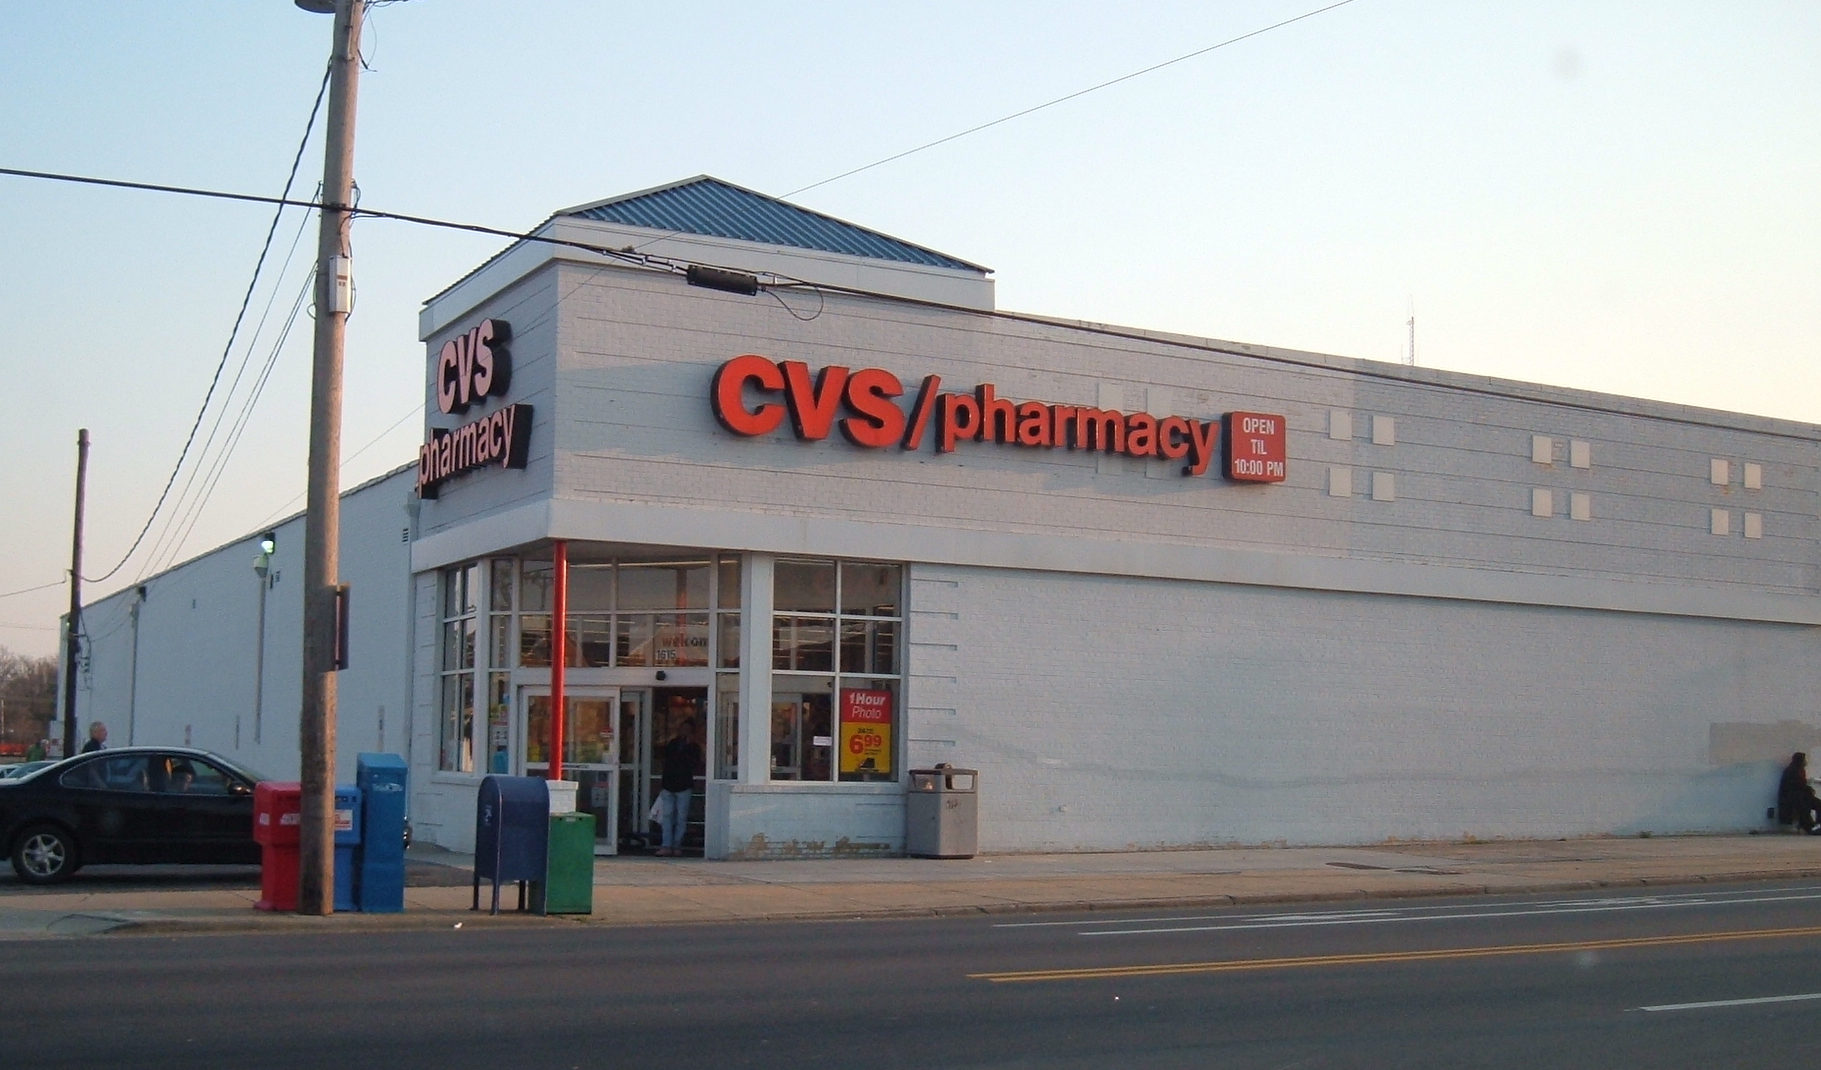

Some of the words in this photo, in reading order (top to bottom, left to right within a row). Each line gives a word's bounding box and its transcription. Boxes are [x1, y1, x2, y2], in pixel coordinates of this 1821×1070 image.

[437, 317, 501, 414] CVS
[1243, 417, 1275, 435] OPEN
[415, 403, 522, 499] pharmacy
[1250, 439, 1267, 455] TIL
[1234, 458, 1263, 475] 10:00
[1266, 461, 1284, 477] PM
[656, 649, 677, 659] 1615
[851, 706, 882, 719] Photo
